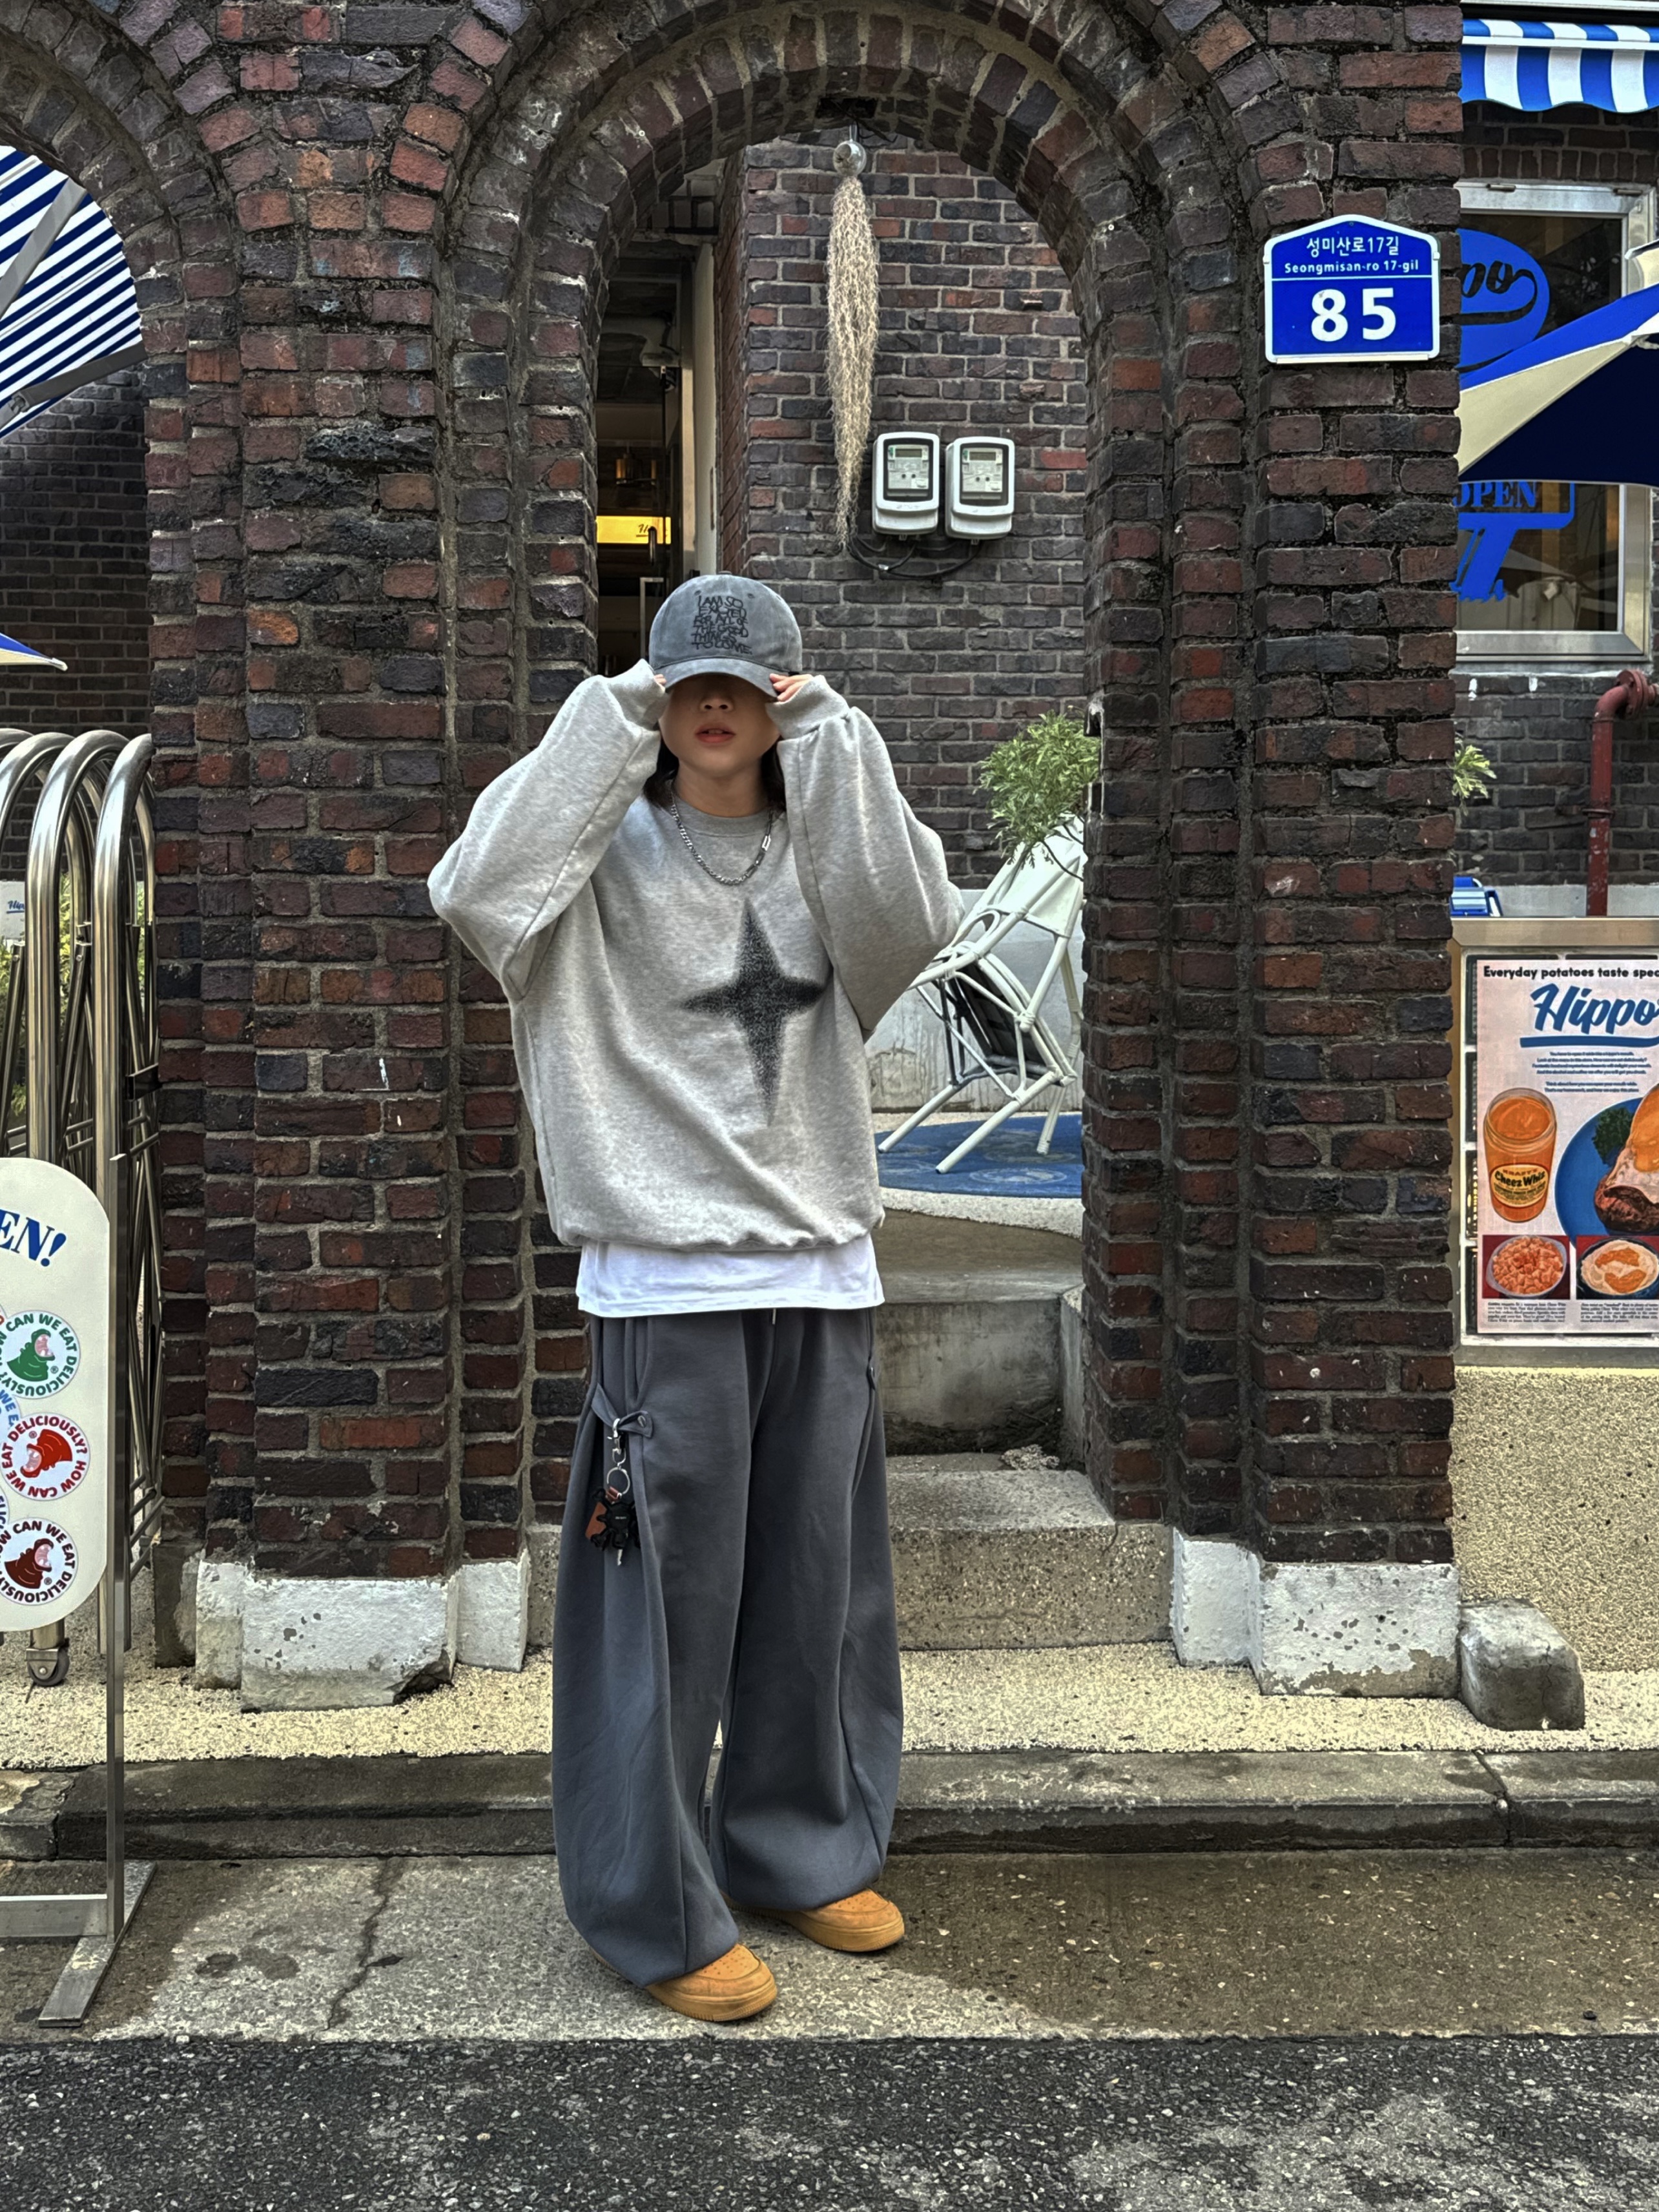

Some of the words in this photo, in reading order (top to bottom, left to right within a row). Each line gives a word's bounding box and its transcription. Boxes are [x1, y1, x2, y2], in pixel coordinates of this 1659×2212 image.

[1306, 236, 1399, 258] 성미산로17길
[1284, 261, 1379, 274] Seongmisan-ro
[1384, 260, 1419, 273] 17-gil
[1311, 287, 1397, 342] 85
[724, 596, 744, 608] SO
[1483, 966, 1538, 980] Everyday
[1541, 967, 1594, 980] potatoes
[1598, 967, 1629, 978] taste
[1530, 982, 1659, 1035] Hippo
[1494, 1170, 1522, 1187] Cheez
[6, 1313, 34, 1332] CAN
[39, 1313, 62, 1330] WE
[59, 1327, 77, 1352] EAT
[8, 1415, 88, 1454] DELICIOUSLY?
[1, 1442, 14, 1469] EAT
[6, 1470, 26, 1492] WE
[60, 1460, 87, 1493] HOW
[27, 1485, 57, 1498] CAN
[13, 1520, 42, 1534] CAN
[45, 1524, 67, 1544] WE
[61, 1543, 76, 1569] EAT
